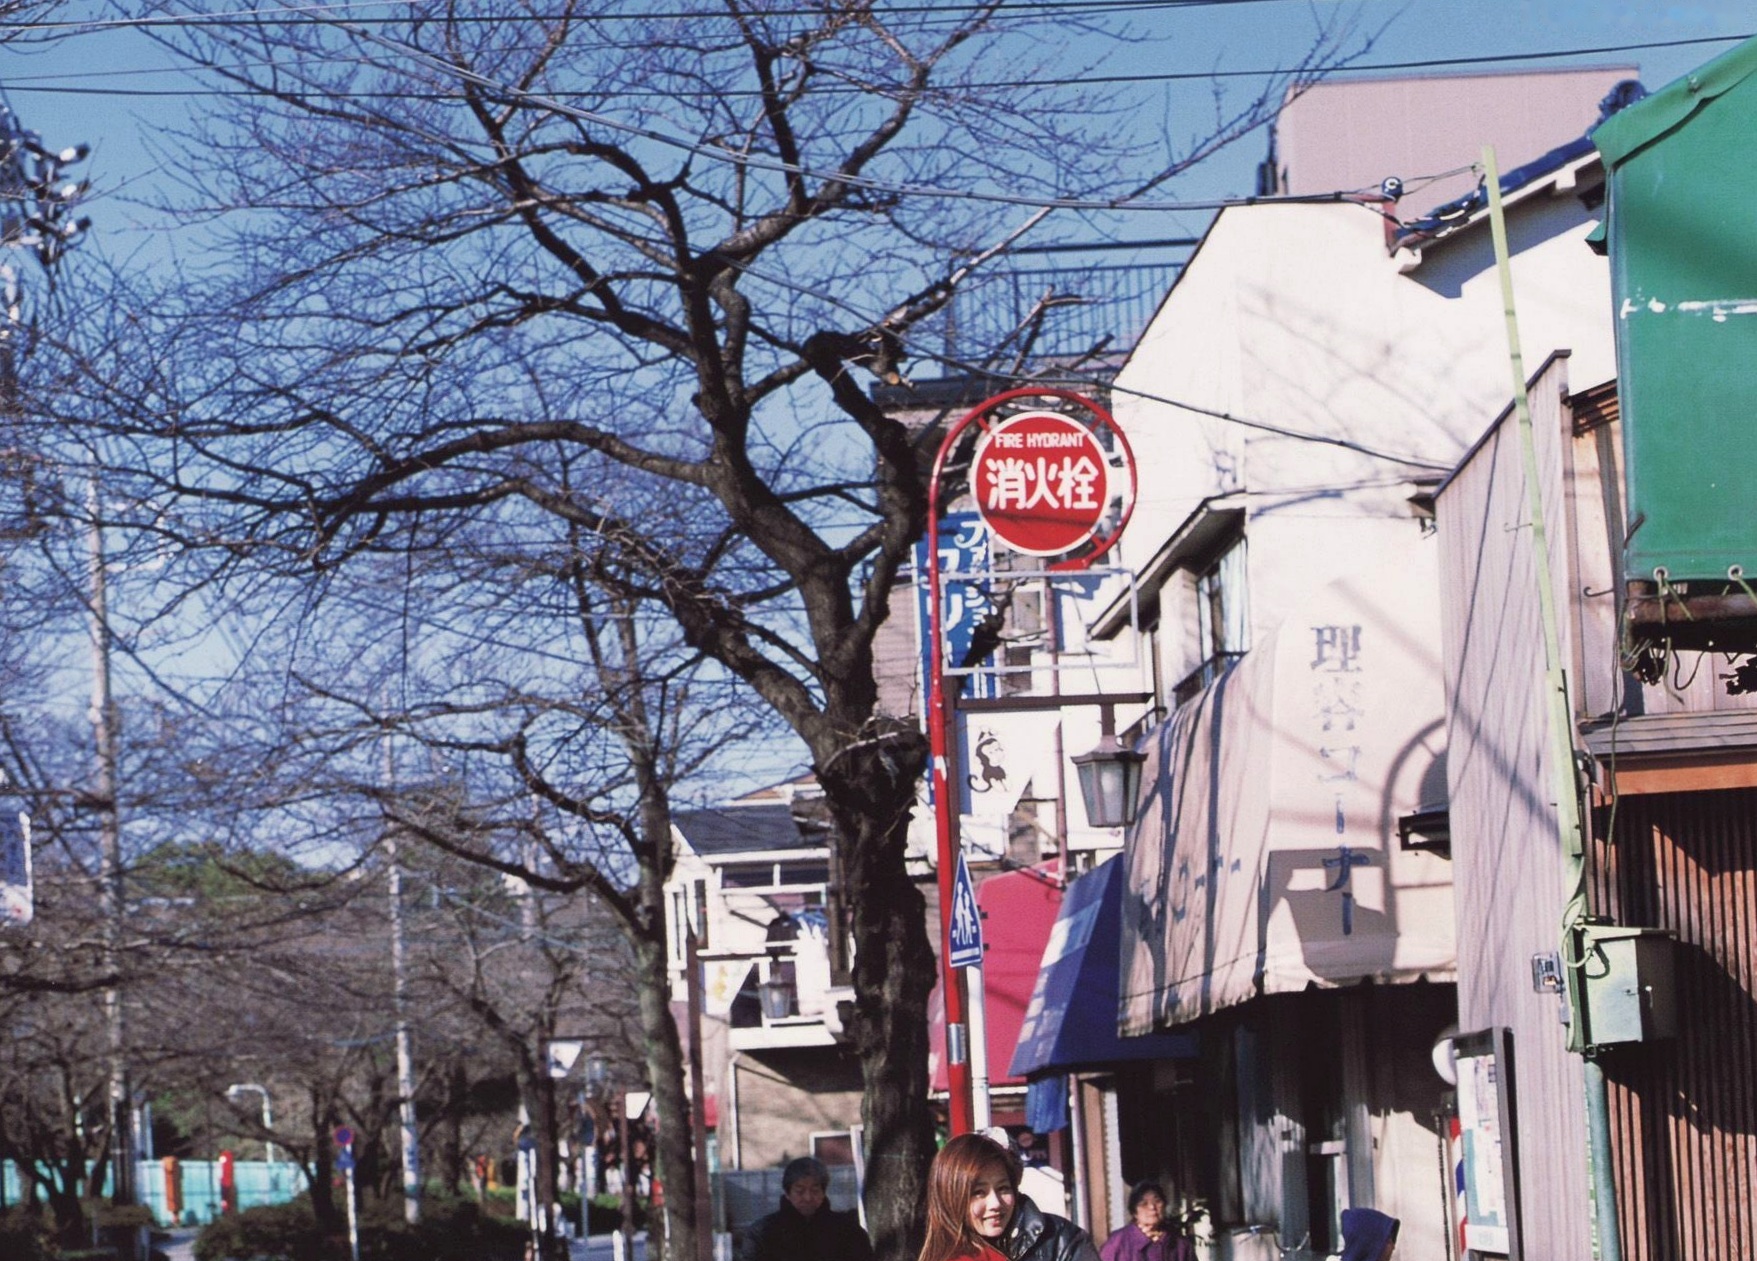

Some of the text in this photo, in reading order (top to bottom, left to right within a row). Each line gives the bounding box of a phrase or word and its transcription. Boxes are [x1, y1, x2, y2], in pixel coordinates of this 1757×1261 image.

[995, 432, 1083, 448] FIRE HYDRANT
[985, 456, 1099, 509] 消火栓
